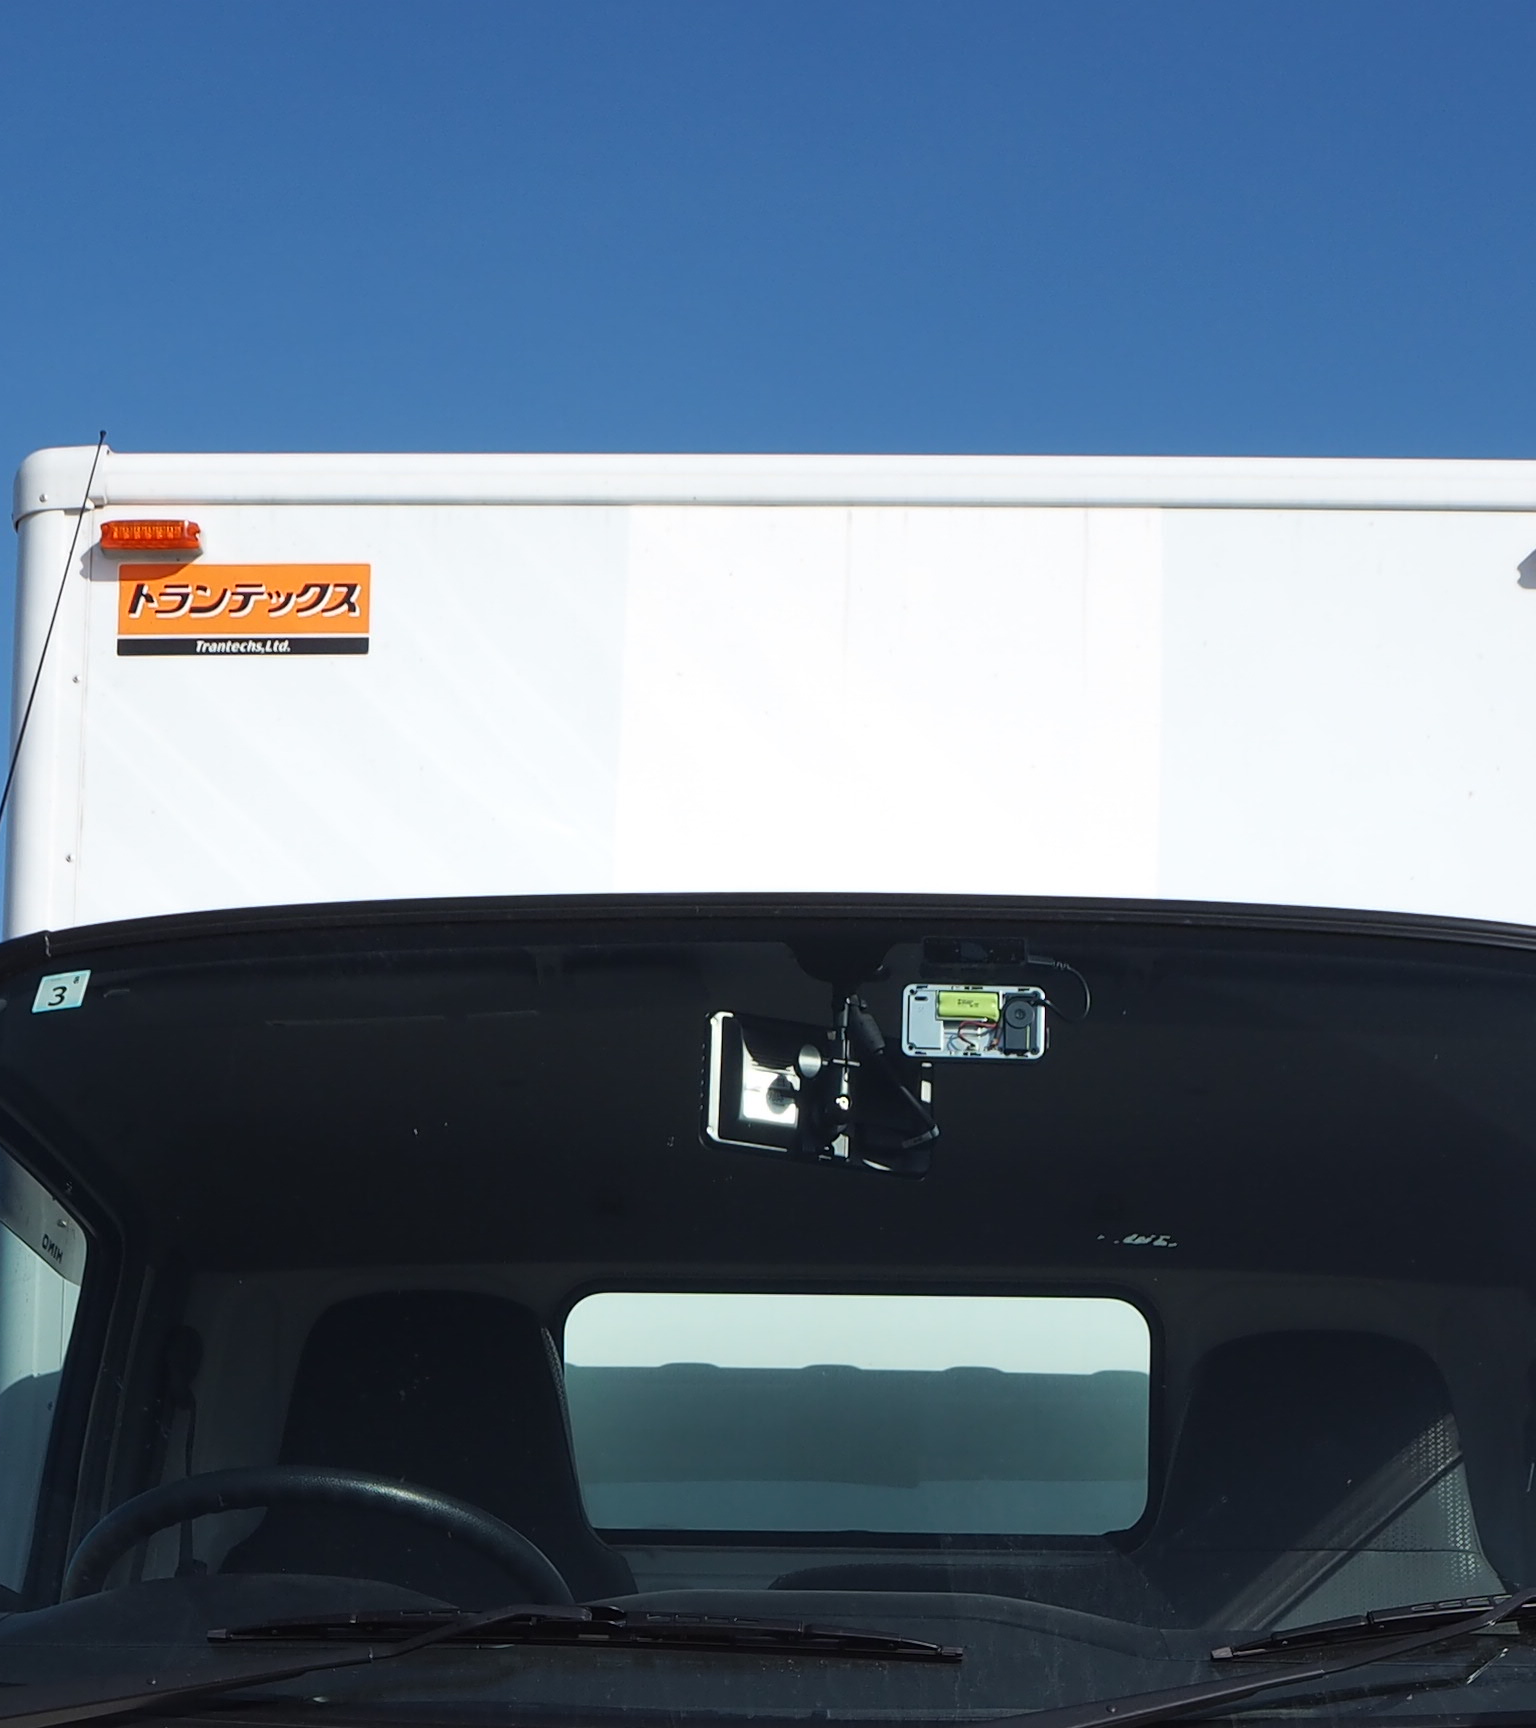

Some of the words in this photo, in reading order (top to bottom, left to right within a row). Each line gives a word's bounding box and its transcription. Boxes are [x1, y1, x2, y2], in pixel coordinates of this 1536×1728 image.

[128, 583, 361, 618] トランテックス
[48, 986, 67, 1006] 3
